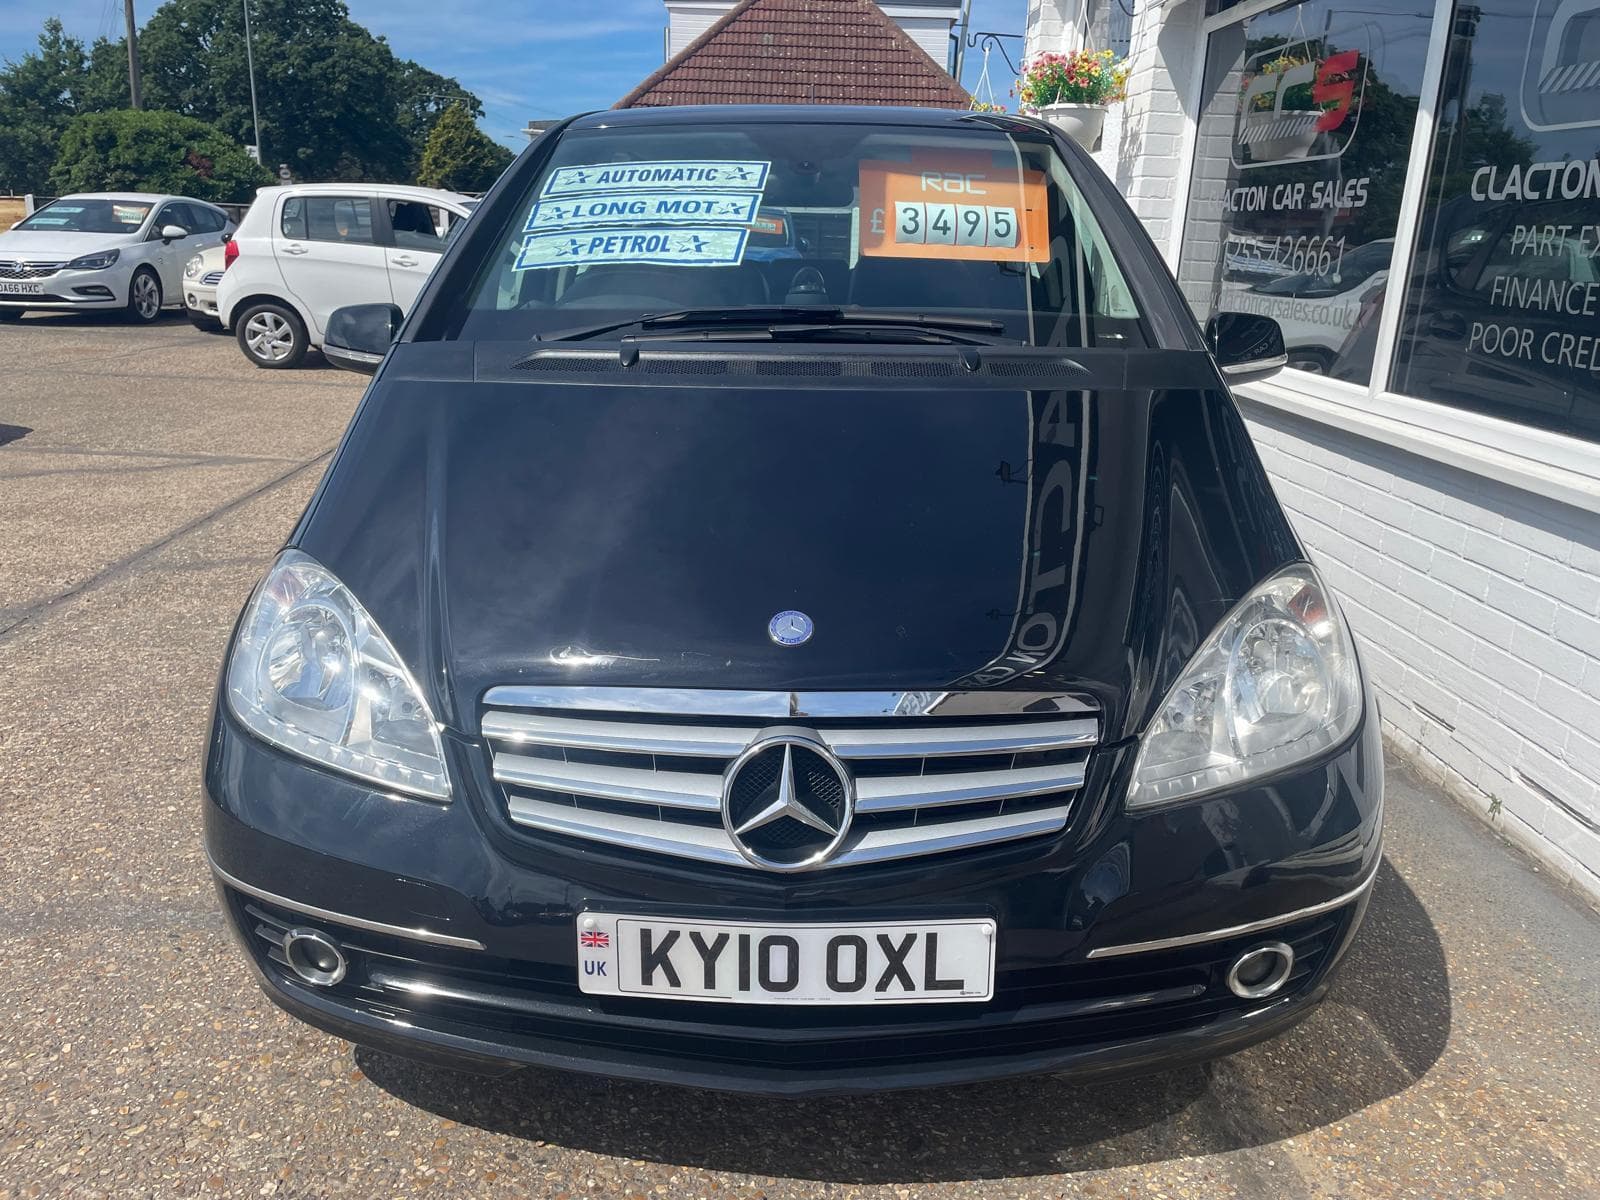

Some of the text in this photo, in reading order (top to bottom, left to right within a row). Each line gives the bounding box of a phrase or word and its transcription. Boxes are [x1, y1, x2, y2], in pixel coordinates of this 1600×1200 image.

[596, 168, 719, 184] AUTOMATIC
[572, 200, 719, 218] LONG MOT
[1272, 183, 1305, 211] CAR
[1310, 177, 1369, 209] SALES
[902, 207, 1012, 239] 3495
[587, 235, 671, 255] PETROL
[1267, 235, 1346, 278] 426661
[1510, 224, 1573, 257] PART
[21, 284, 40, 293] HXC
[1490, 275, 1600, 316] FINANCE
[1469, 322, 1534, 360] POOR
[584, 960, 607, 977] UK
[640, 928, 964, 993] KY10 OXL
